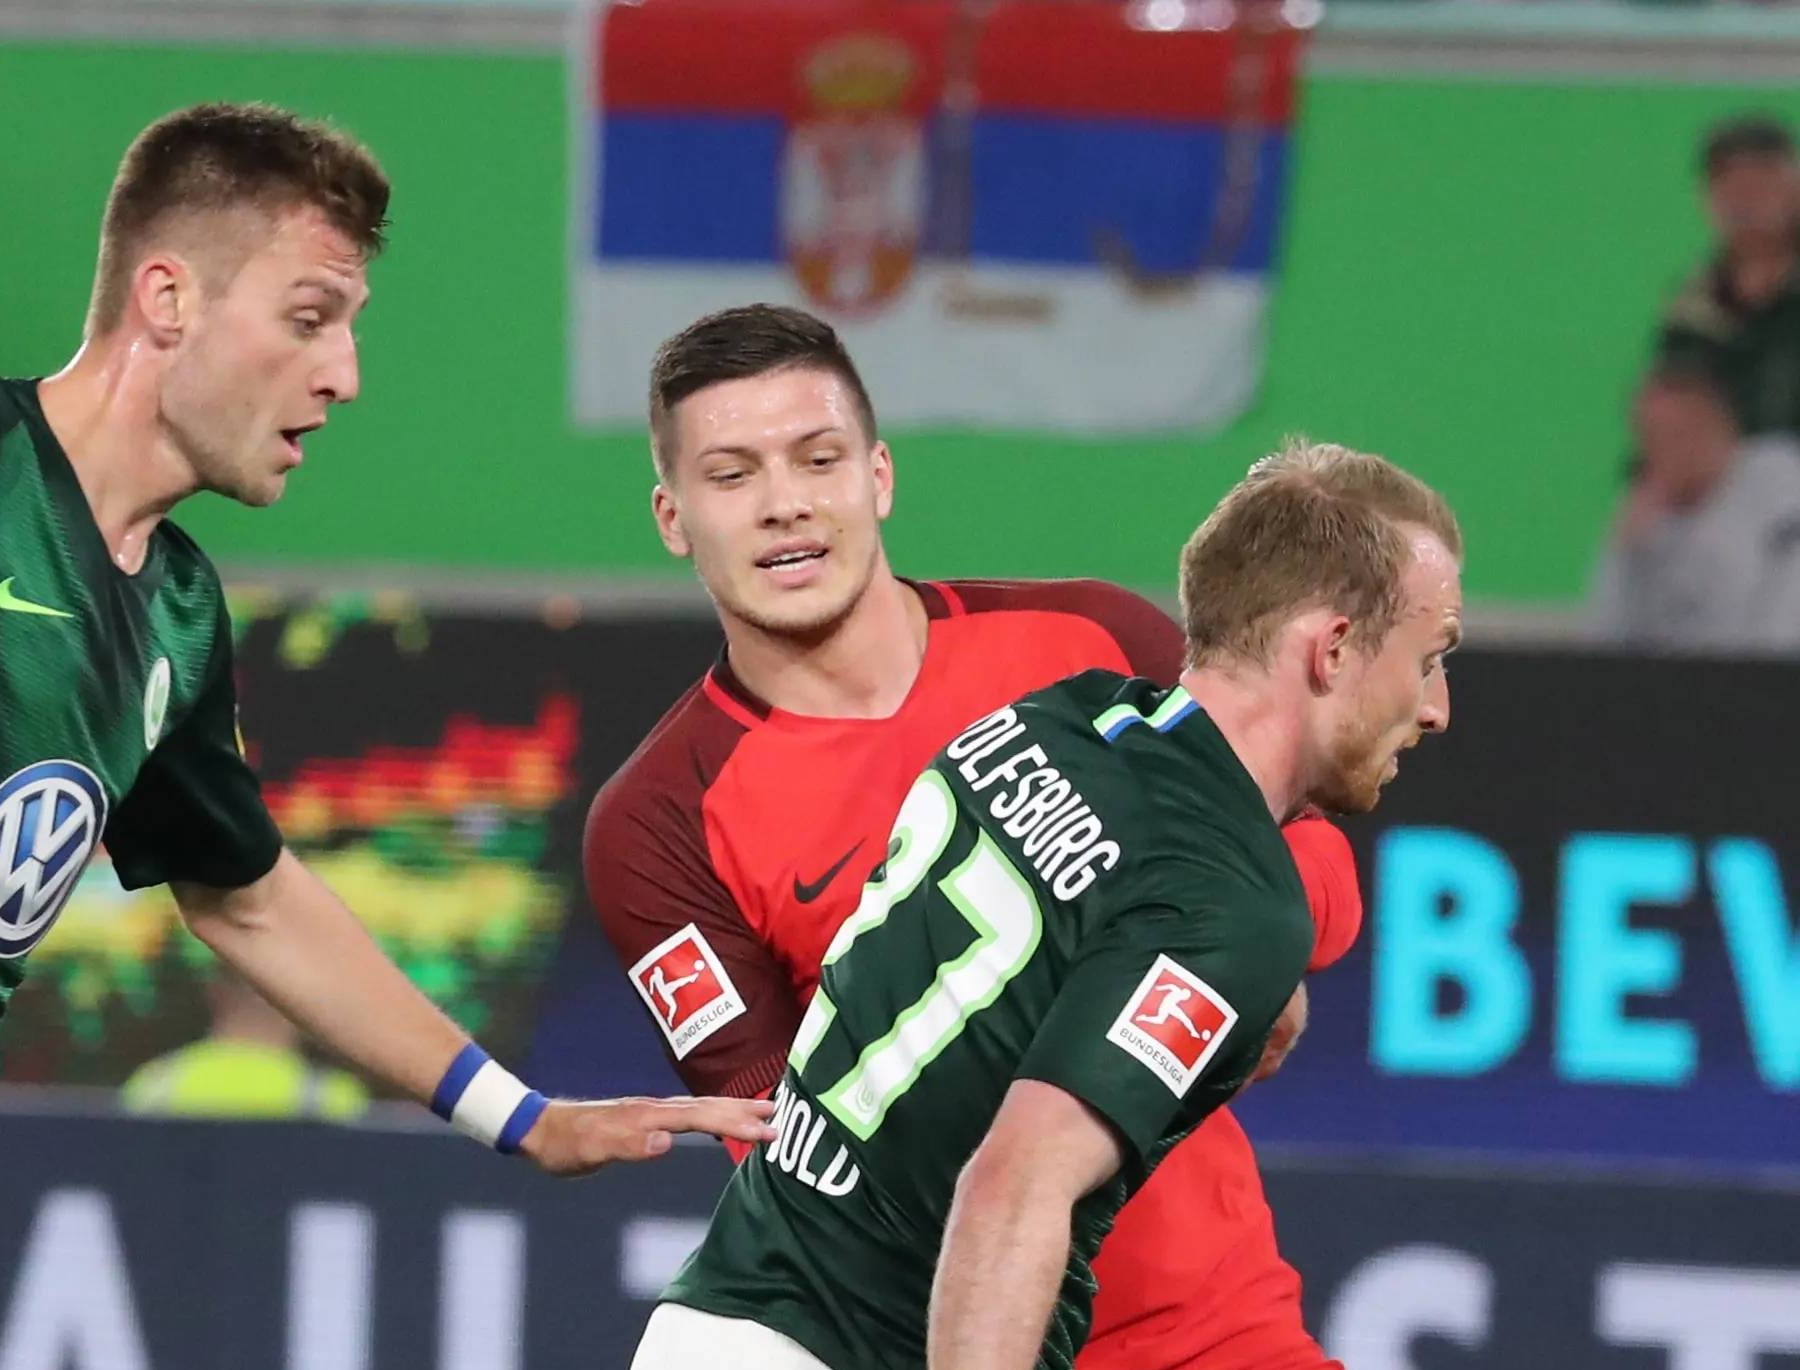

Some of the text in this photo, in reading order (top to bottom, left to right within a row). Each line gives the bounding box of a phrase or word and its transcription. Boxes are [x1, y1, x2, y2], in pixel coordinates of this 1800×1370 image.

[946, 704, 1121, 902] OLFSBURG
[675, 1000, 734, 1049] BUNDESLIGA
[1118, 1027, 1185, 1086] BUNDESLIGA
